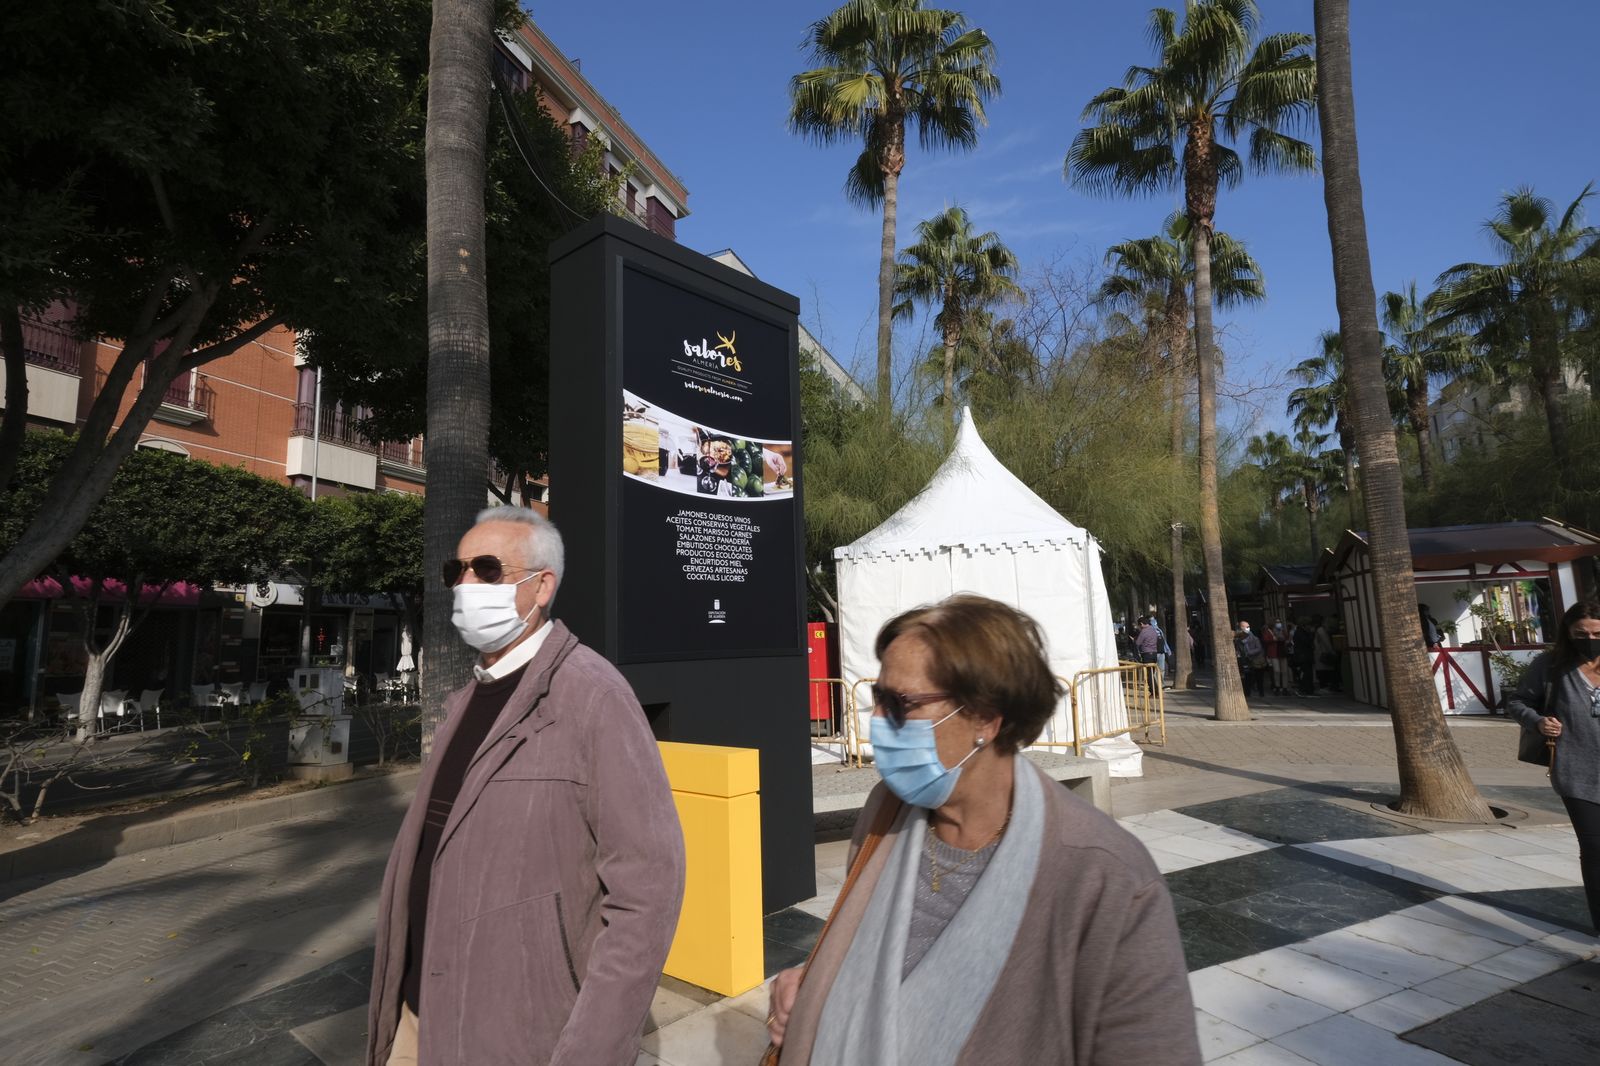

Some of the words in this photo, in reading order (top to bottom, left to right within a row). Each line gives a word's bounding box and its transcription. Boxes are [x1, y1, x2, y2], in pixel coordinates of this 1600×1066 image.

[683, 338, 743, 372] sabores
[677, 510, 707, 519] JAMONES
[709, 513, 733, 522] QUESOS
[666, 516, 692, 525] ACEITES
[693, 520, 728, 529] CONSERVAS
[730, 523, 760, 532] VEGETALES
[676, 525, 701, 533] TOMATE
[703, 527, 729, 536] MARISCO
[731, 531, 753, 539] CARNES
[680, 533, 716, 543] SALAZONES
[717, 536, 750, 546] PANADERÍA
[677, 541, 713, 550] EMBUTIDOS
[714, 544, 752, 553] CHOCOLATES
[676, 549, 715, 558] PRODUCTOS
[716, 551, 753, 561] ECOLÓGICOS
[690, 558, 728, 567] ENCURTIDOS
[683, 565, 714, 573] CERVEZAS
[715, 566, 748, 575] ARTESANAS
[687, 573, 720, 581] COCKTAILS
[721, 574, 745, 582] LICORES
